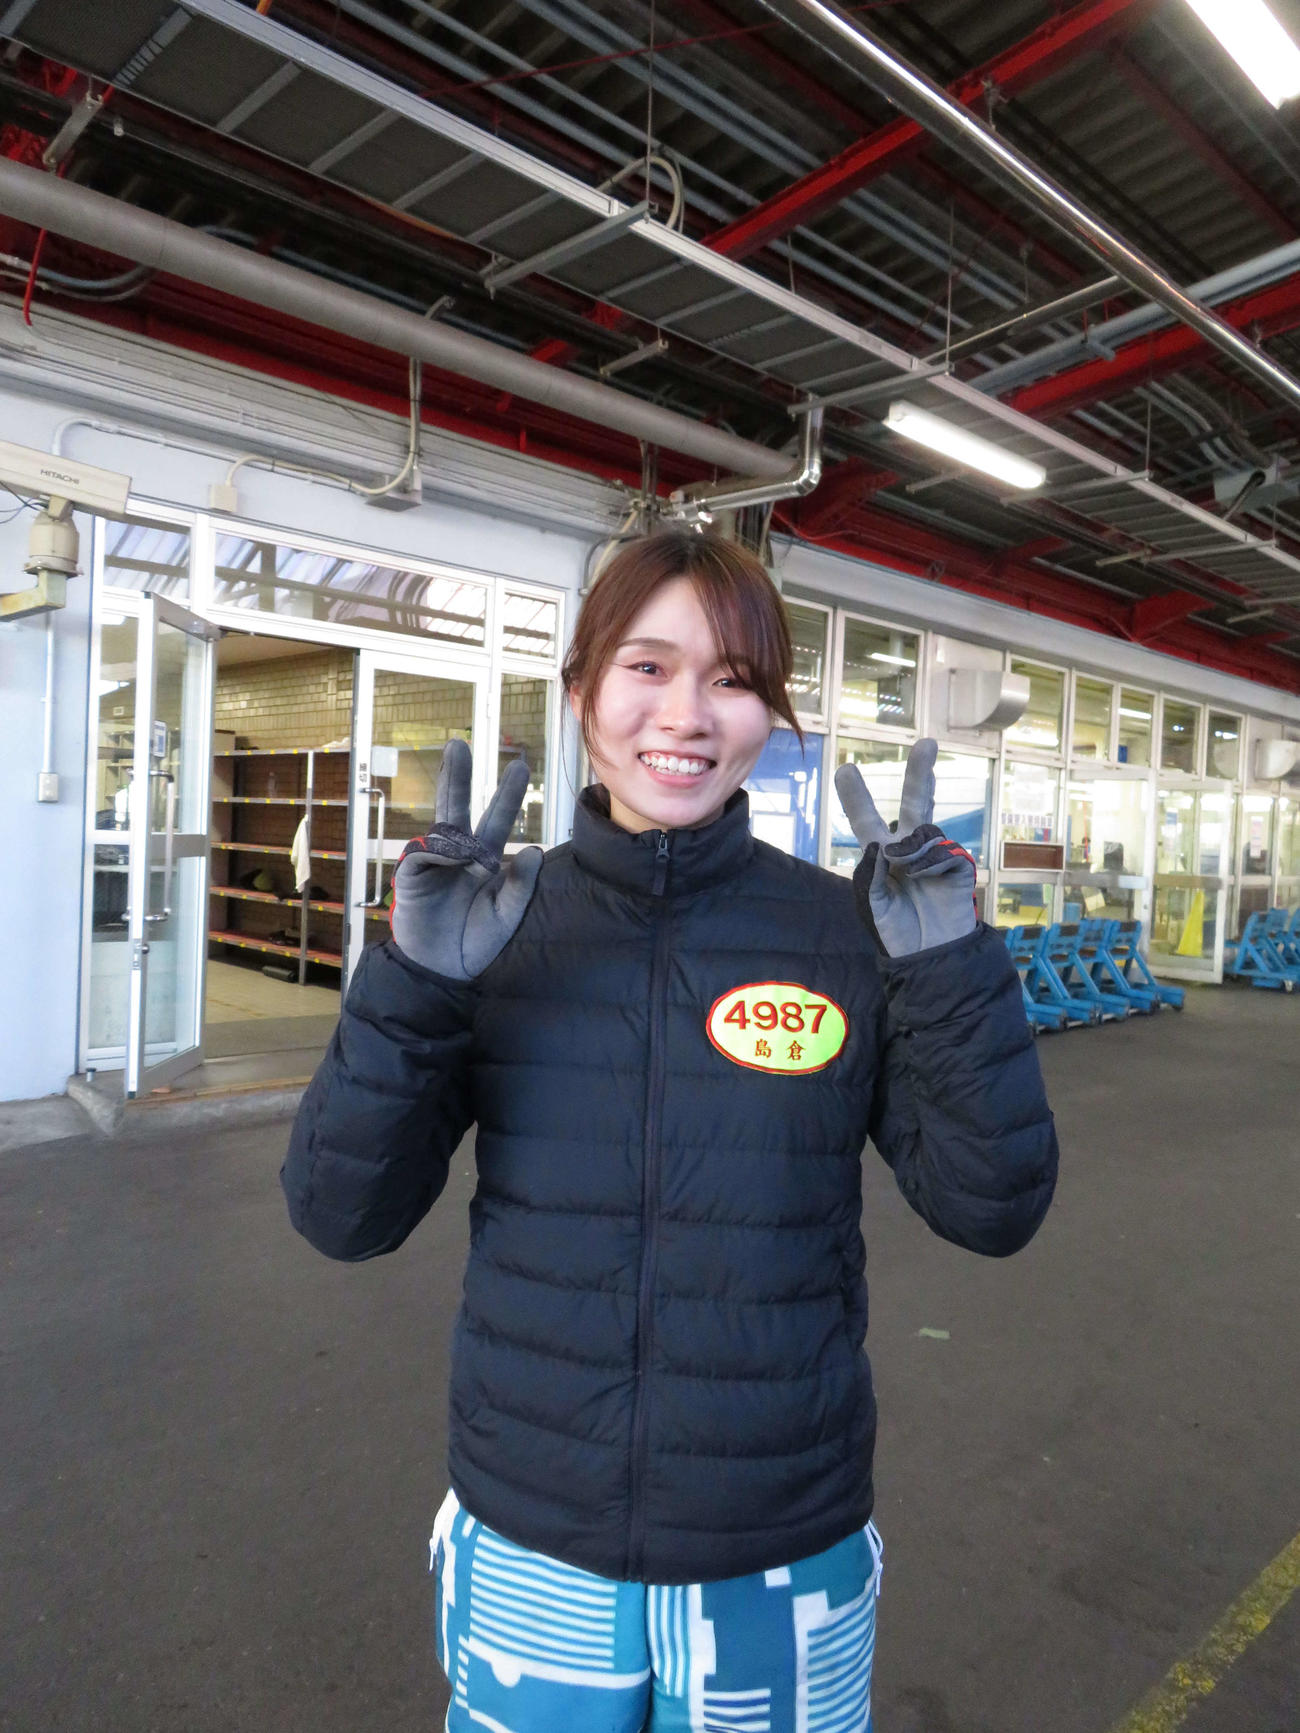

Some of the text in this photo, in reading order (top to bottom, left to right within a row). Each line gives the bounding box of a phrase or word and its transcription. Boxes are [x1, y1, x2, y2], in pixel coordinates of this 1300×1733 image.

[40, 469, 80, 485] HITACHI
[724, 1000, 827, 1034] 4987
[755, 1038, 806, 1061] 島倉
